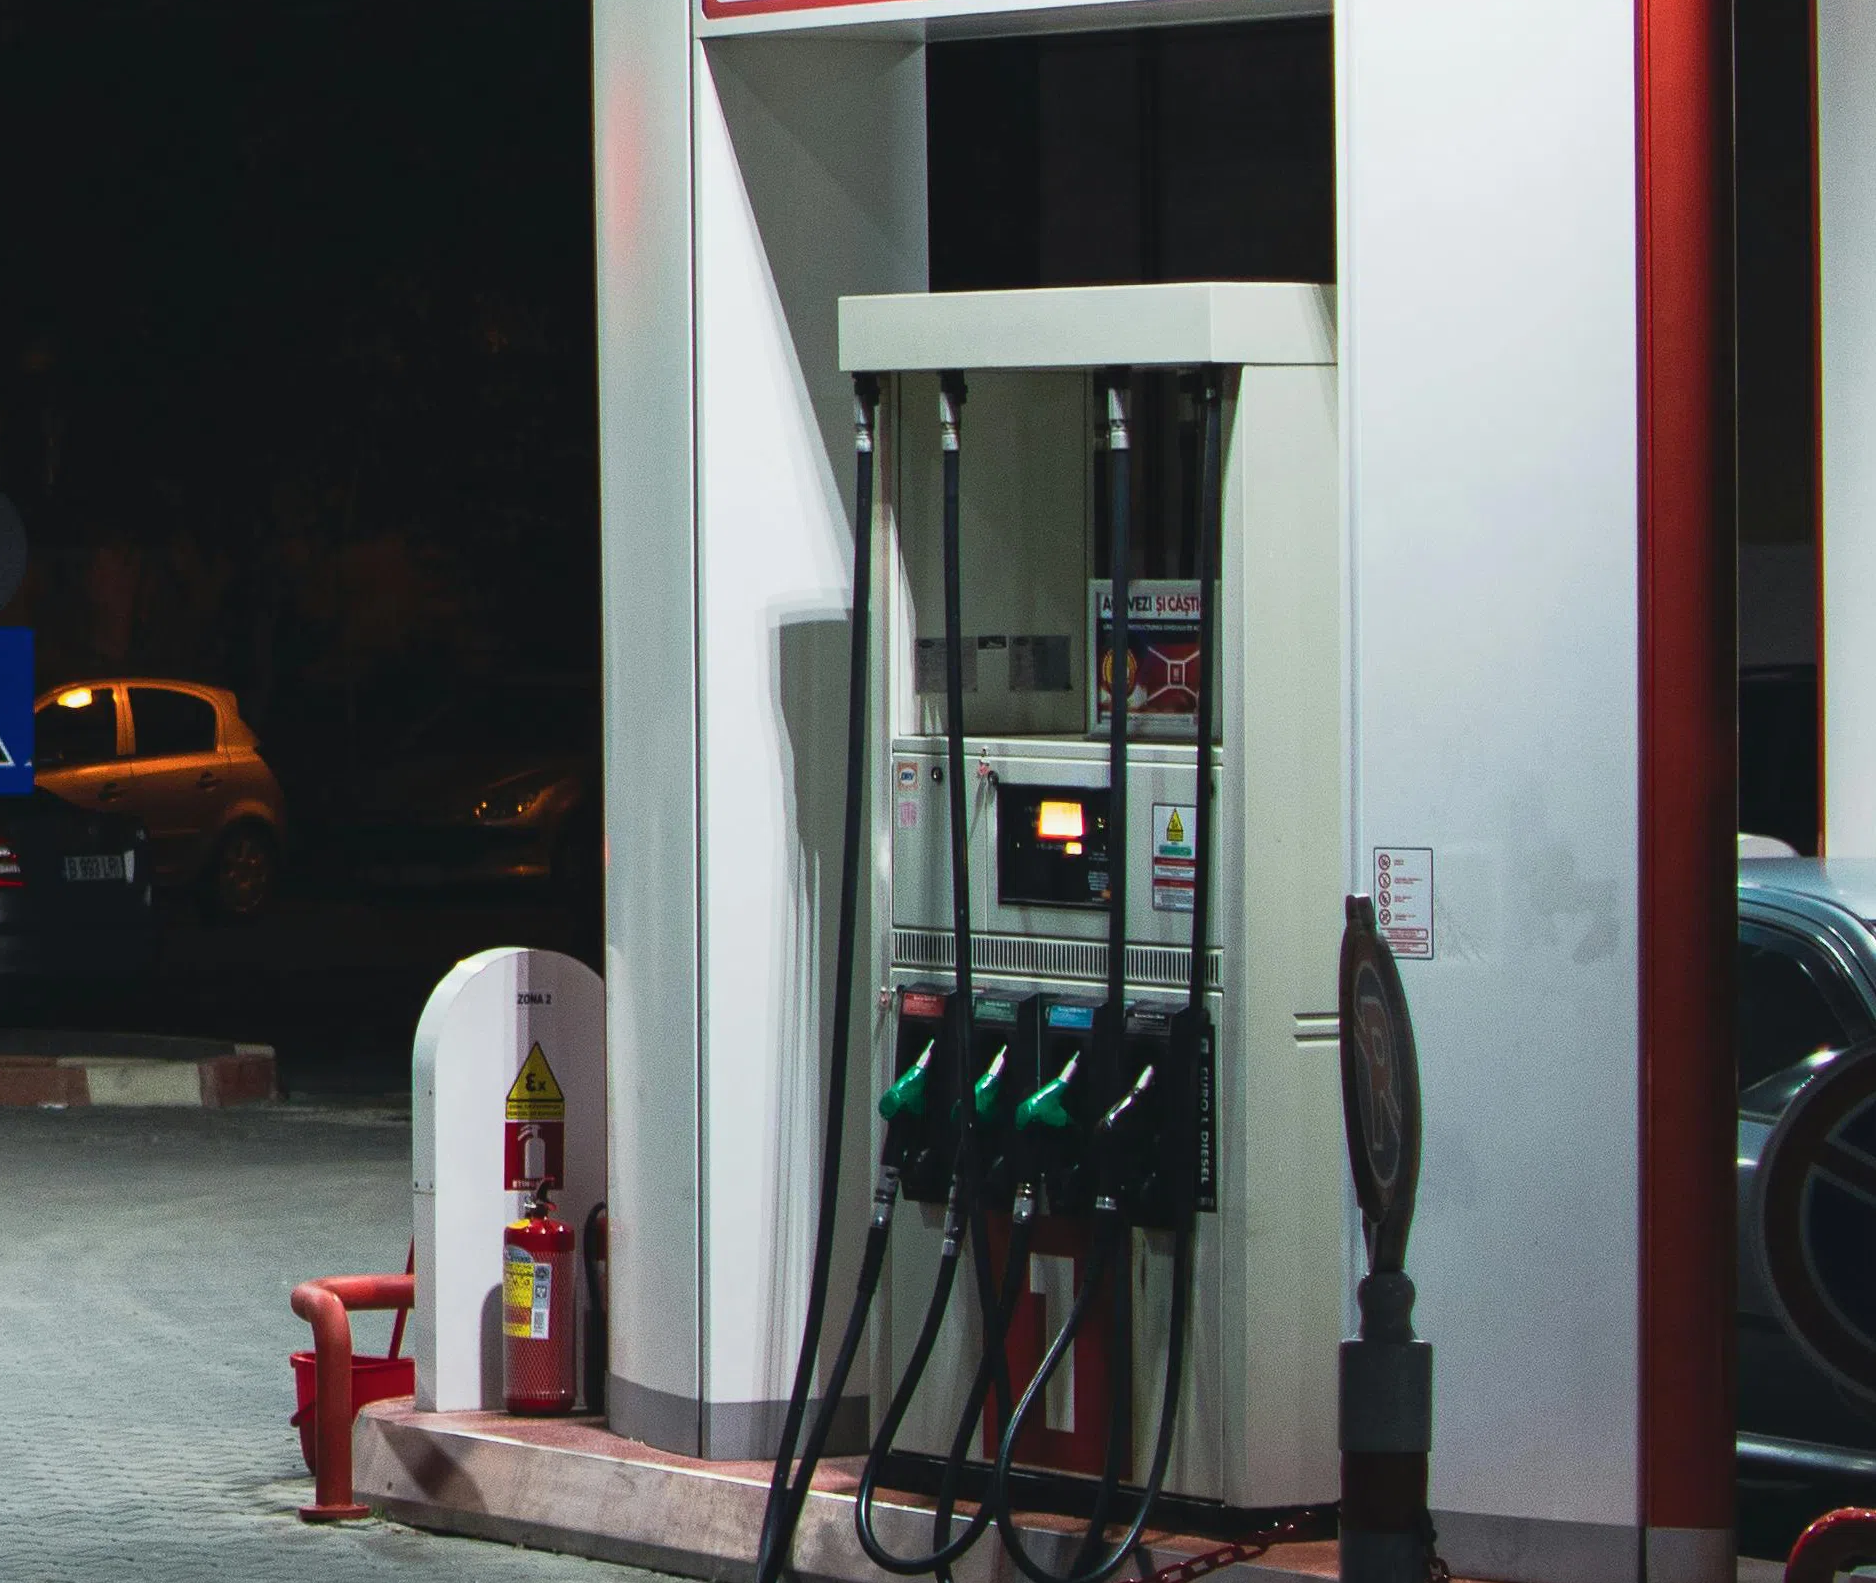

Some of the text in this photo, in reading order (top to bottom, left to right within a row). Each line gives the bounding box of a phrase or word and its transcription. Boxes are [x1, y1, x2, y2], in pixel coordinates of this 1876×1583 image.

[517, 993, 552, 1005] ZONA 2
[524, 1072, 546, 1093] Ex
[1201, 1130, 1210, 1184] DIESEL
